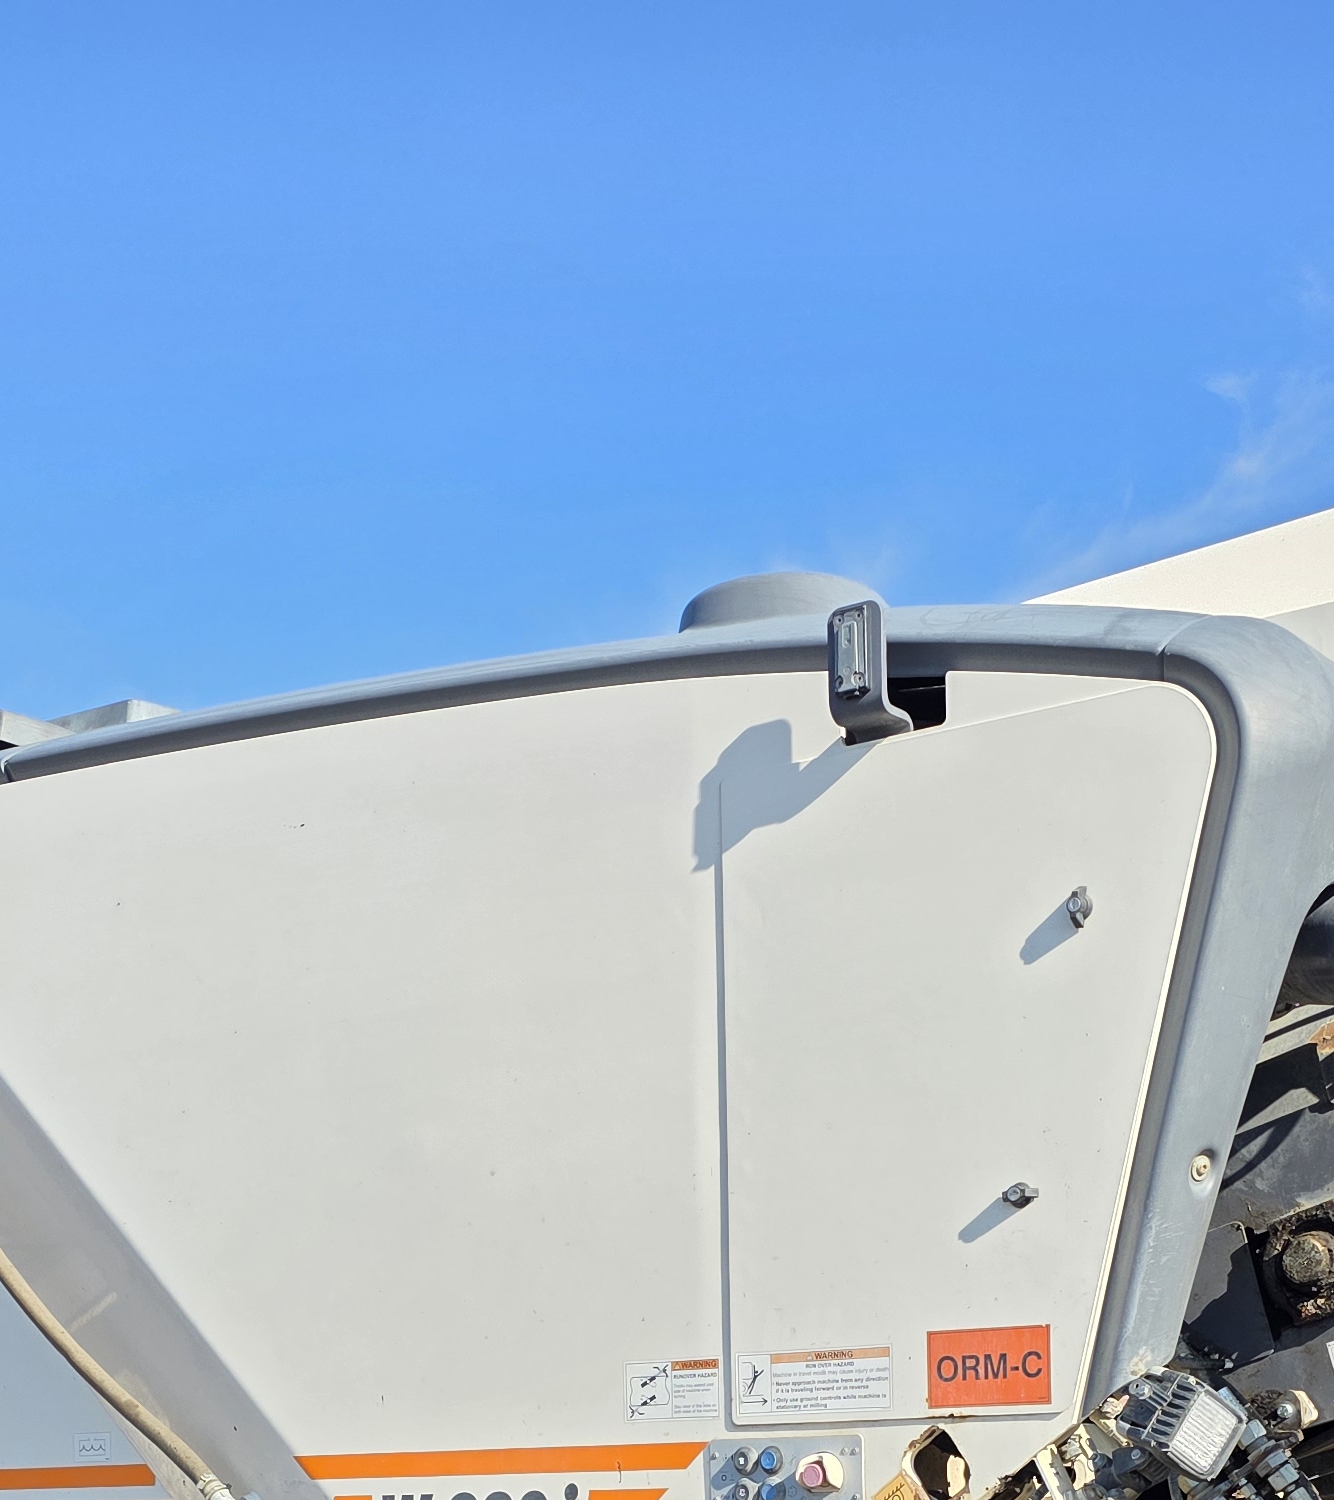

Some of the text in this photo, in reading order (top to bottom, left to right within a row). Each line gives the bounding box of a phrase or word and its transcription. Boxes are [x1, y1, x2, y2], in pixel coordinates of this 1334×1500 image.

[815, 1350, 853, 1360] WARNING
[681, 1360, 717, 1369] WARNING
[936, 1350, 1043, 1382] ORM-C
[793, 1379, 816, 1387] approach
[792, 1385, 814, 1394] traveling
